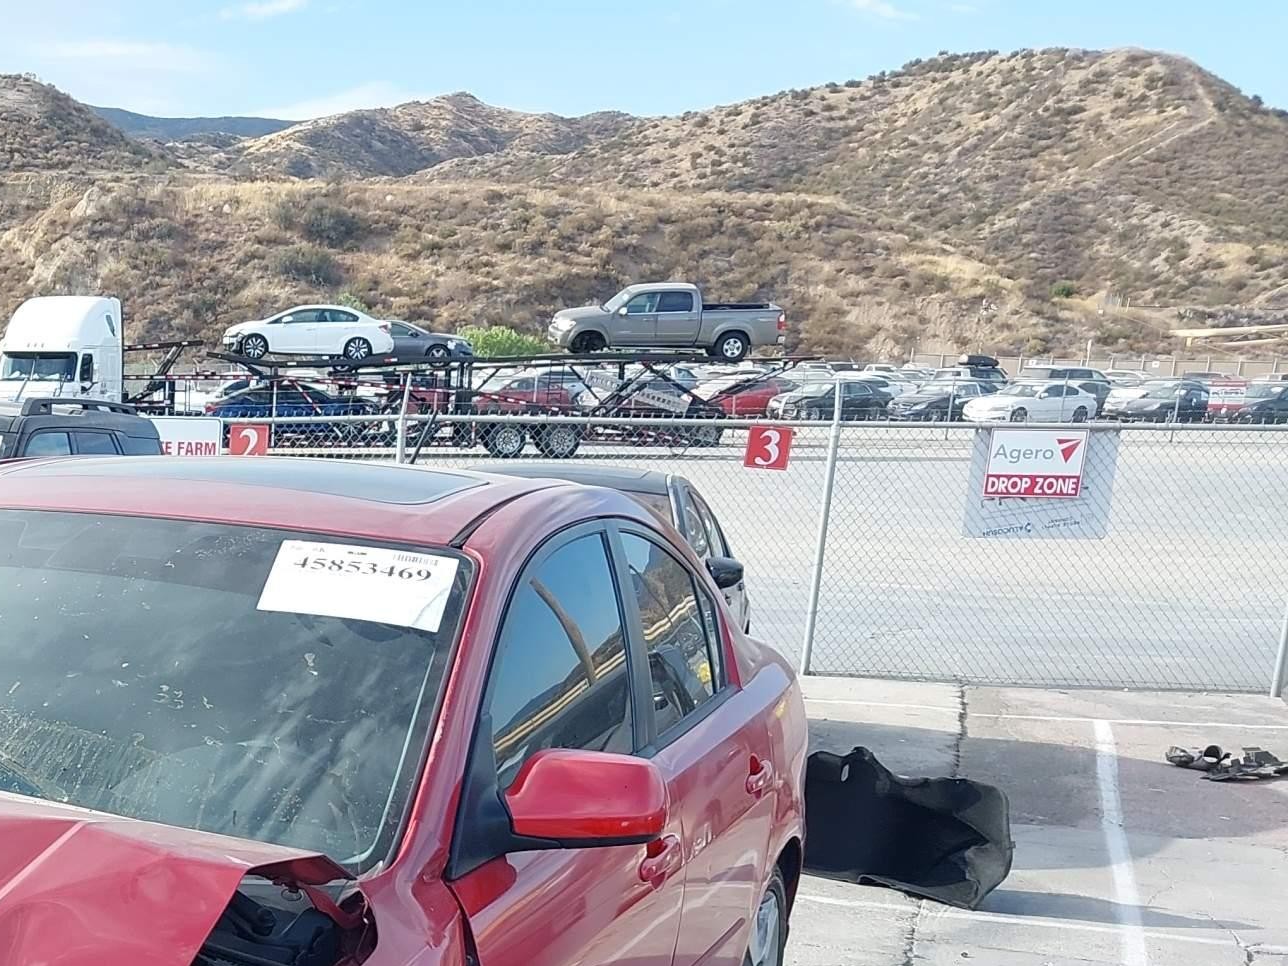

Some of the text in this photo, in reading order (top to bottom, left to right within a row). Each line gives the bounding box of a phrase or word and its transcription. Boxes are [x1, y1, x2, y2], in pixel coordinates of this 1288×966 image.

[178, 441, 217, 456] FARM
[239, 428, 259, 456] 2
[754, 430, 780, 466] 3
[992, 443, 1054, 464] Agero
[987, 477, 1077, 494] DROP ZONE
[293, 556, 432, 582] 45853469
